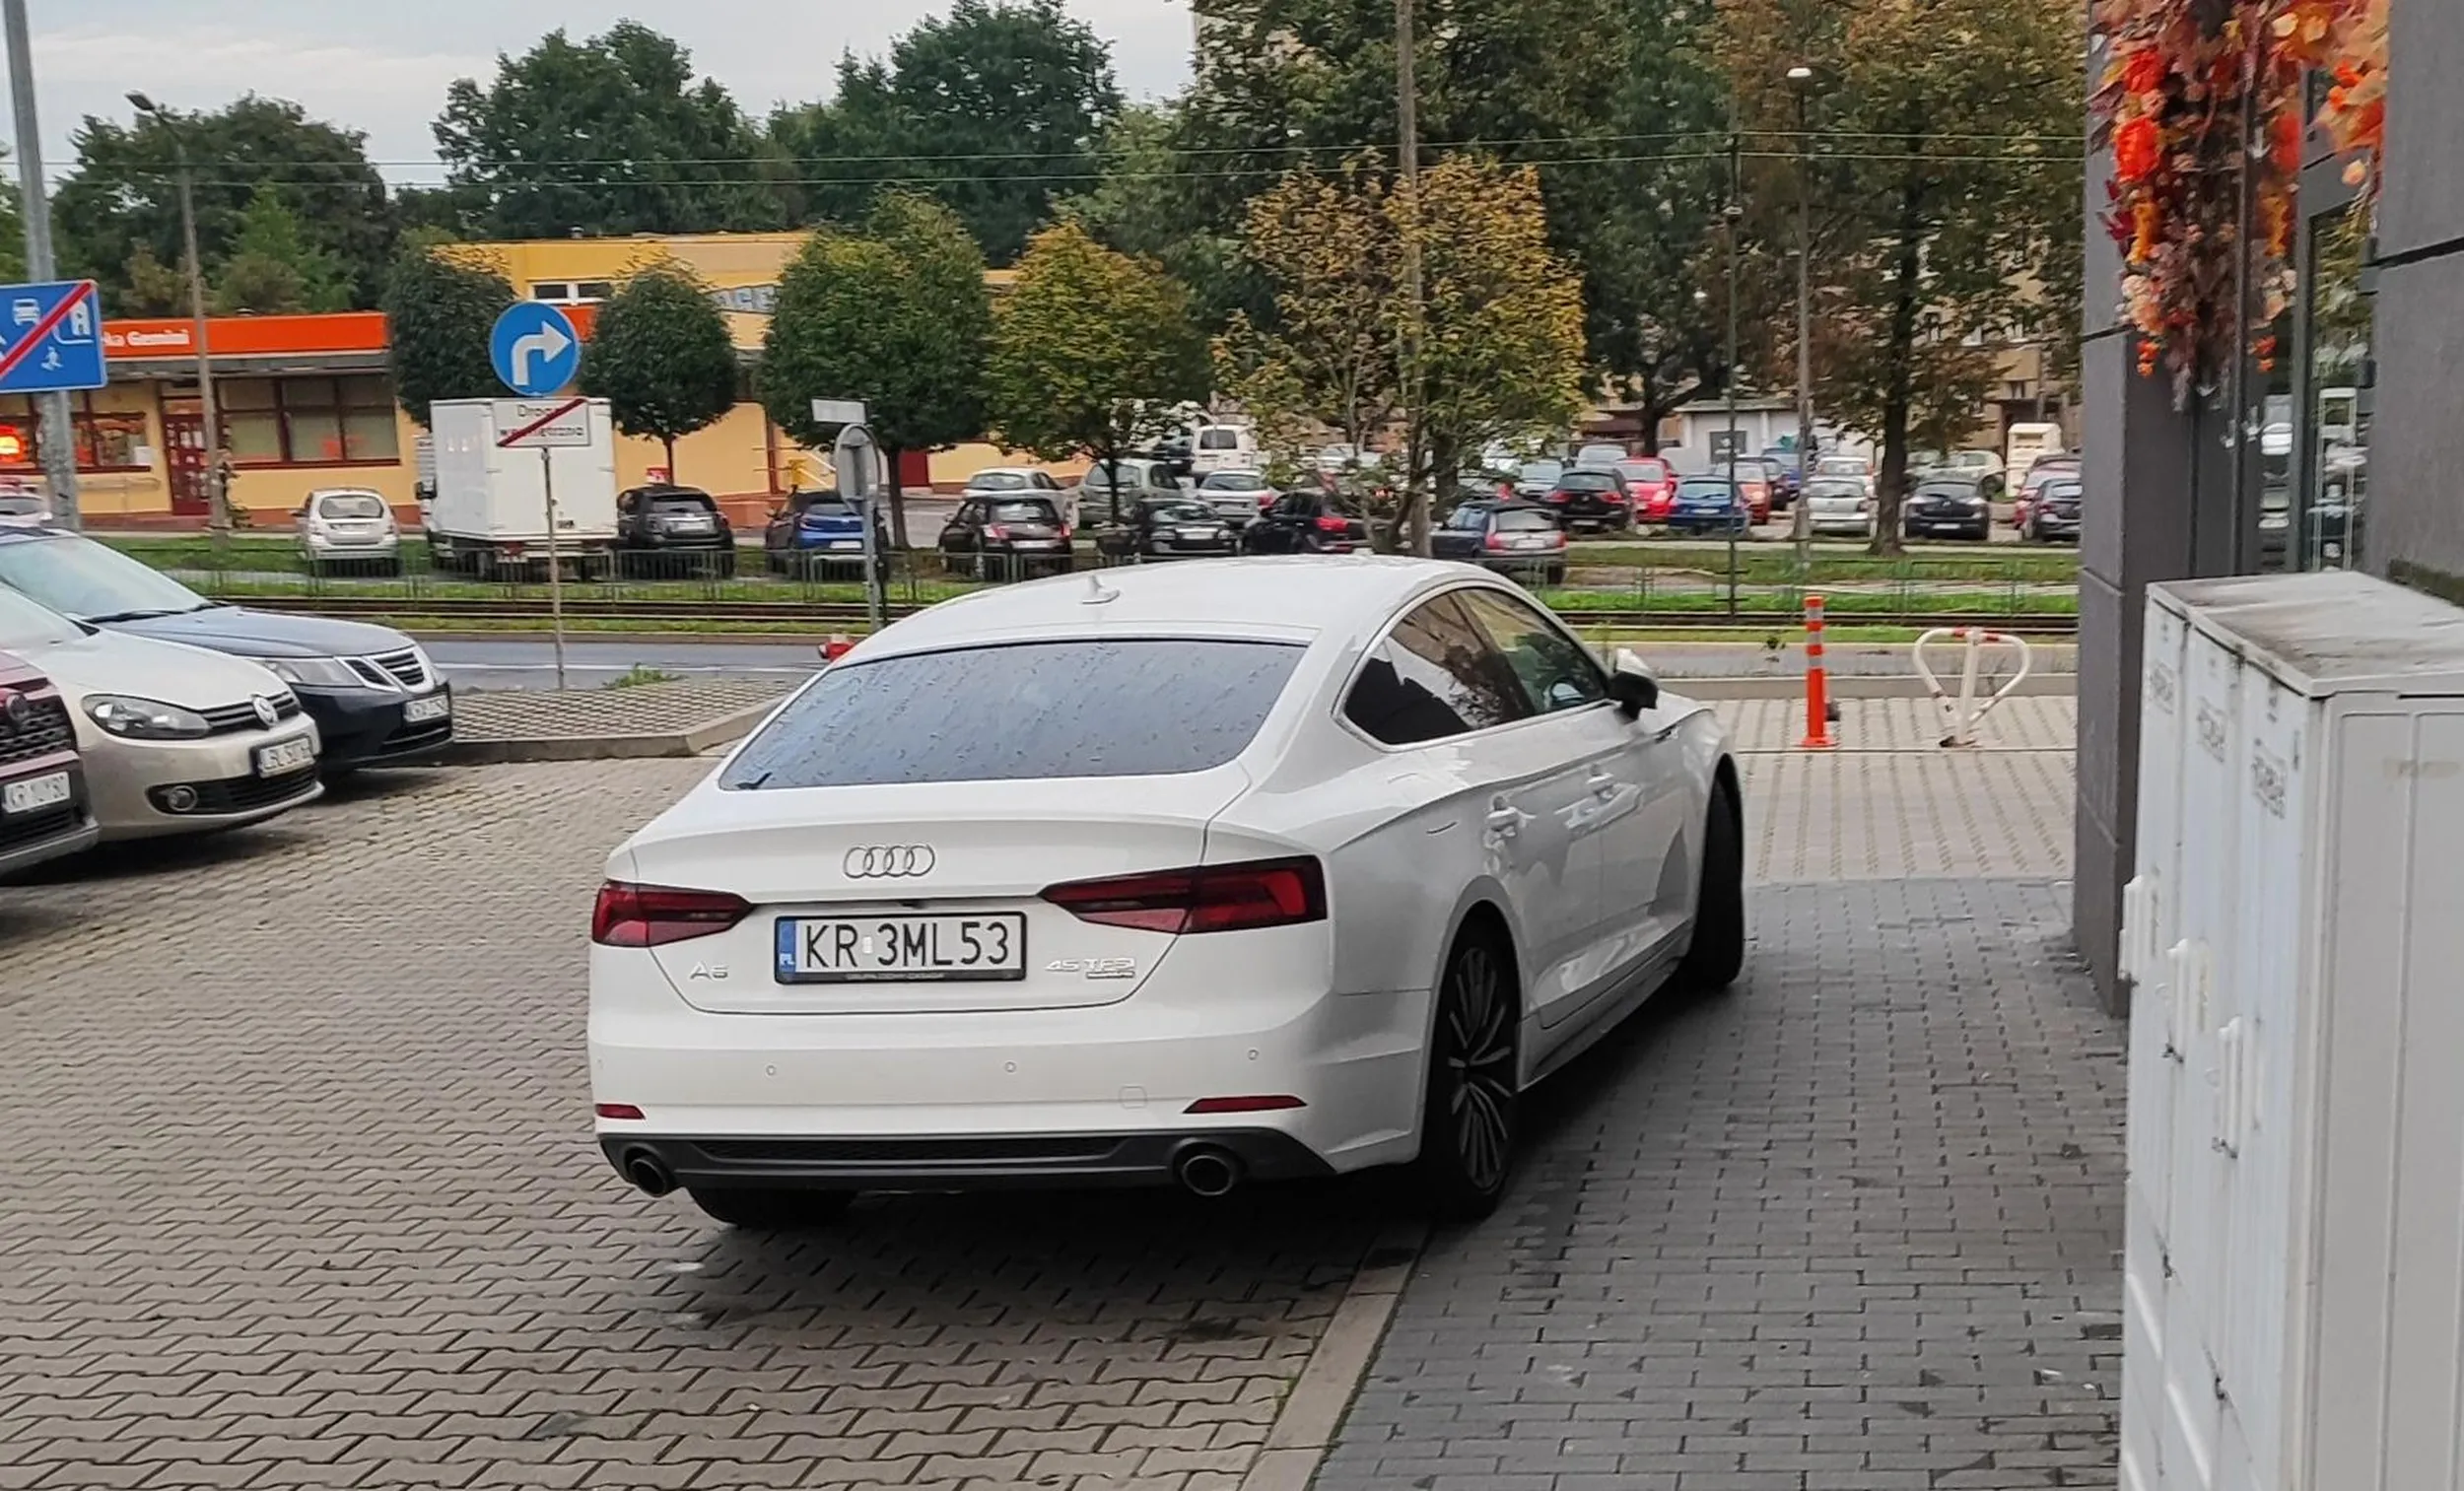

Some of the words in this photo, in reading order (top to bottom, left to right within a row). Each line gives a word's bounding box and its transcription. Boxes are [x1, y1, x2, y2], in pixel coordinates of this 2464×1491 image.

[805, 923, 858, 968] KR
[877, 920, 1009, 967] 3ML53
[1044, 960, 1081, 972] 45
